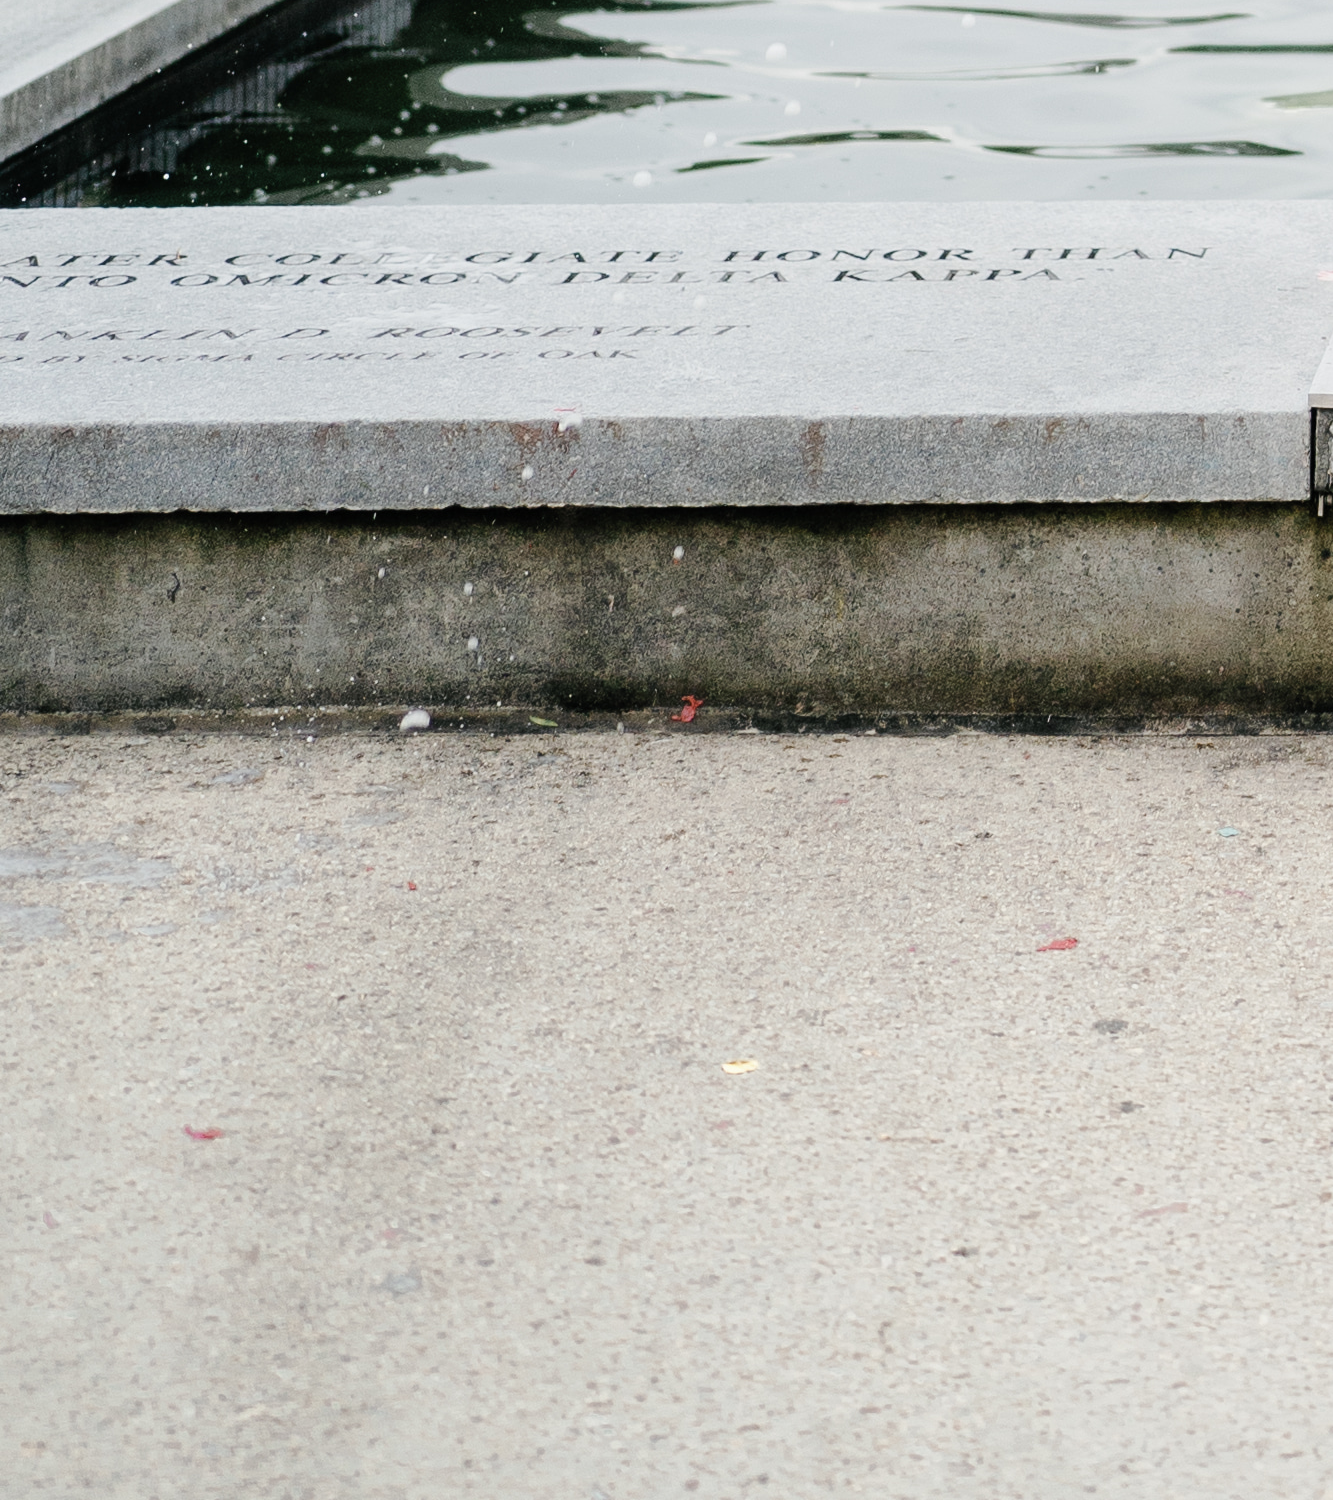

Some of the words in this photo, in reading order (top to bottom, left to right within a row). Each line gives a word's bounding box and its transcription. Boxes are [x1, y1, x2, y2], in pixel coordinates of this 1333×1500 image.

[225, 250, 683, 266] COLLEGIATE
[722, 248, 974, 263] HONOR
[1012, 248, 1210, 260] THAN
[171, 272, 525, 287] OMICRON
[552, 270, 790, 284] DELTA
[367, 325, 751, 338] ROOSEVELT
[537, 350, 638, 360] OAK
